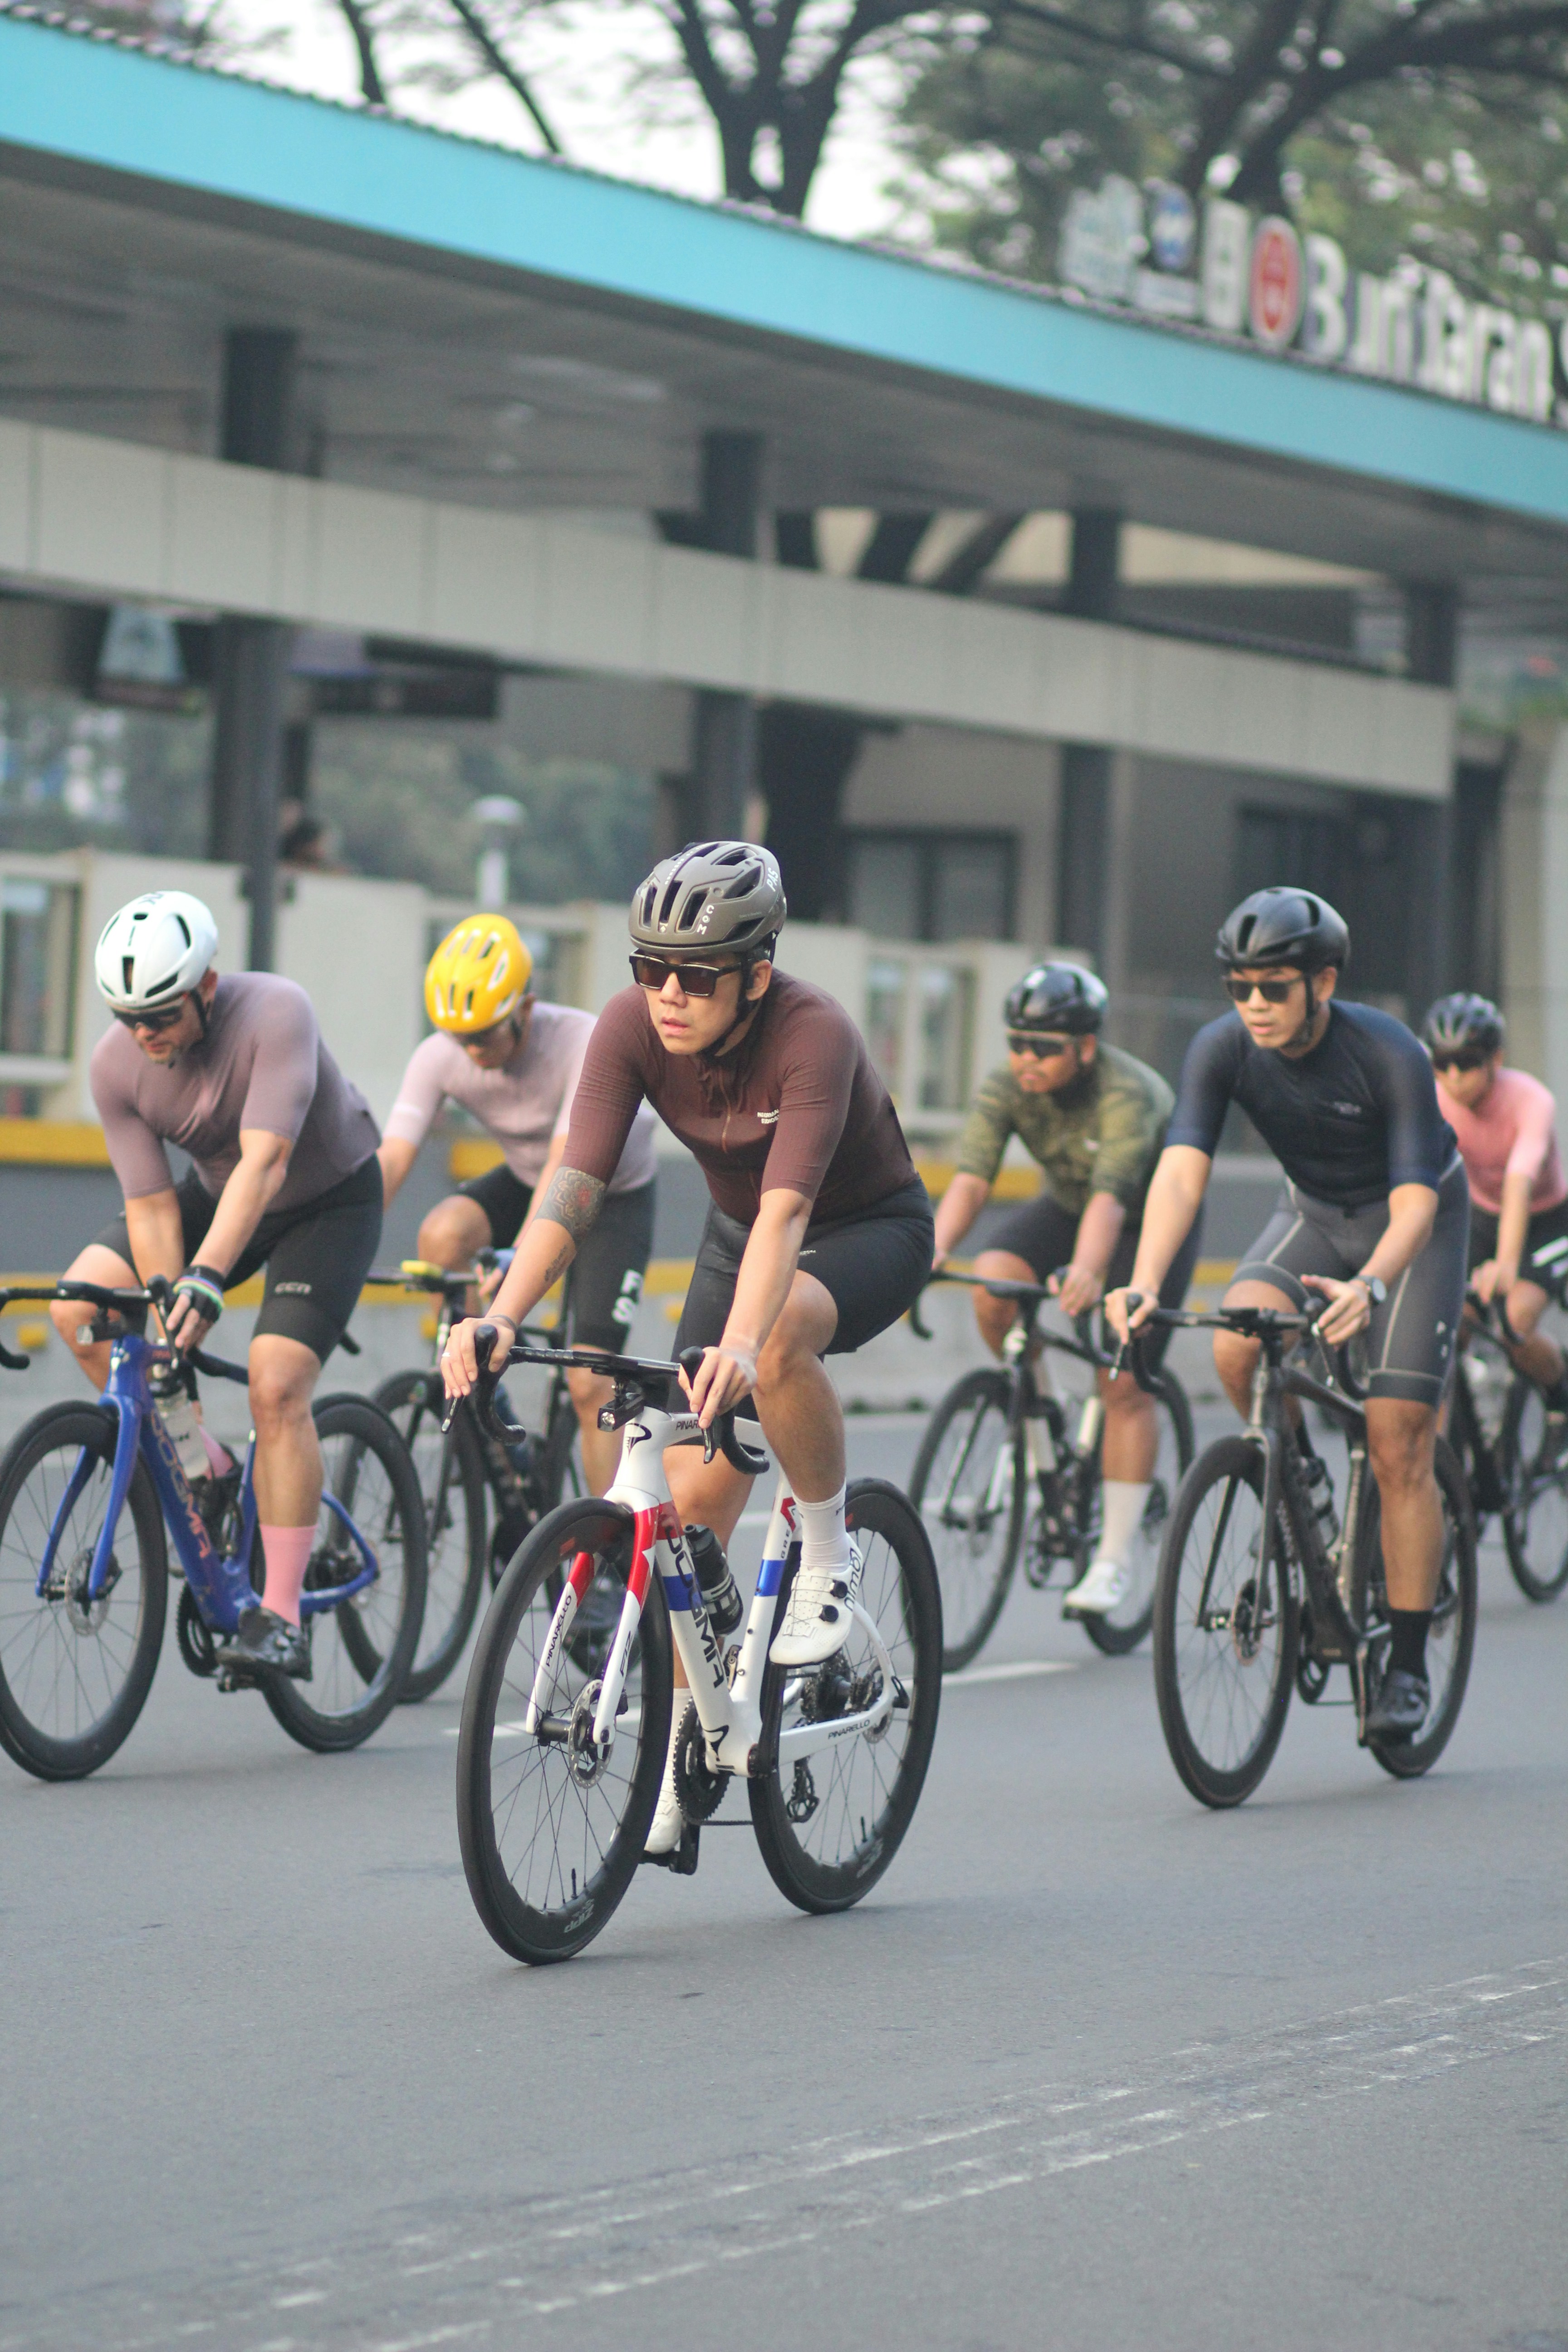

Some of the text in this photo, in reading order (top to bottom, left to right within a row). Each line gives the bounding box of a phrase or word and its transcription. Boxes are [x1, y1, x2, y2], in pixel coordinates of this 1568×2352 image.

[766, 867, 779, 892] PAS
[676, 1420, 699, 1431] PINAR
[546, 1595, 572, 1667] PINARELLO
[828, 1720, 870, 1739] PINARELLO
